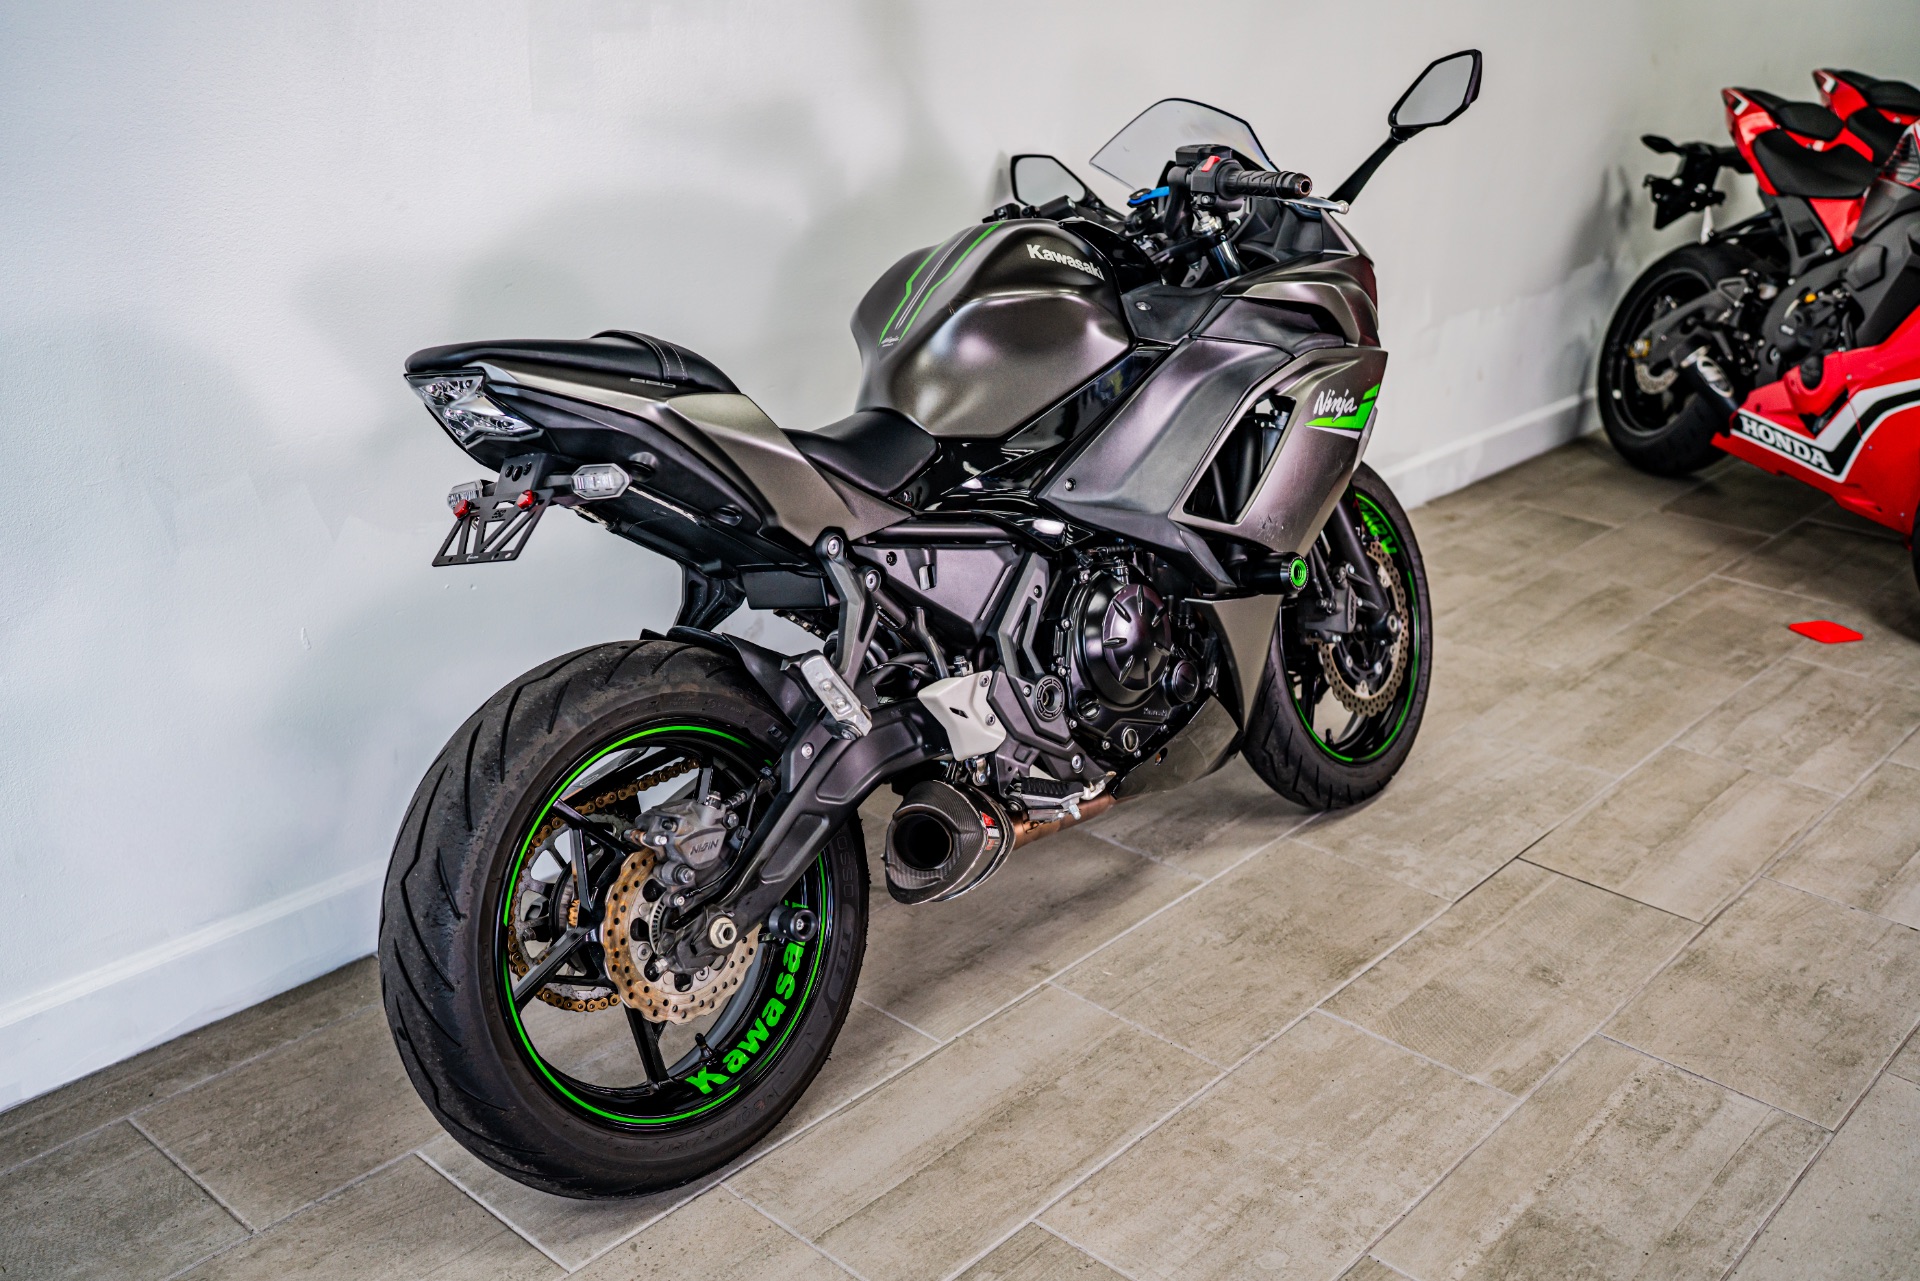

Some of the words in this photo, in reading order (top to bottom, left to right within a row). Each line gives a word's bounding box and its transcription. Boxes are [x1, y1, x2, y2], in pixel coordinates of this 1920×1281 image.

[1026, 244, 1105, 281] Kawasaki
[1313, 388, 1358, 422] Ninja
[1739, 415, 1834, 473] HONDA
[837, 831, 855, 898] OSSO
